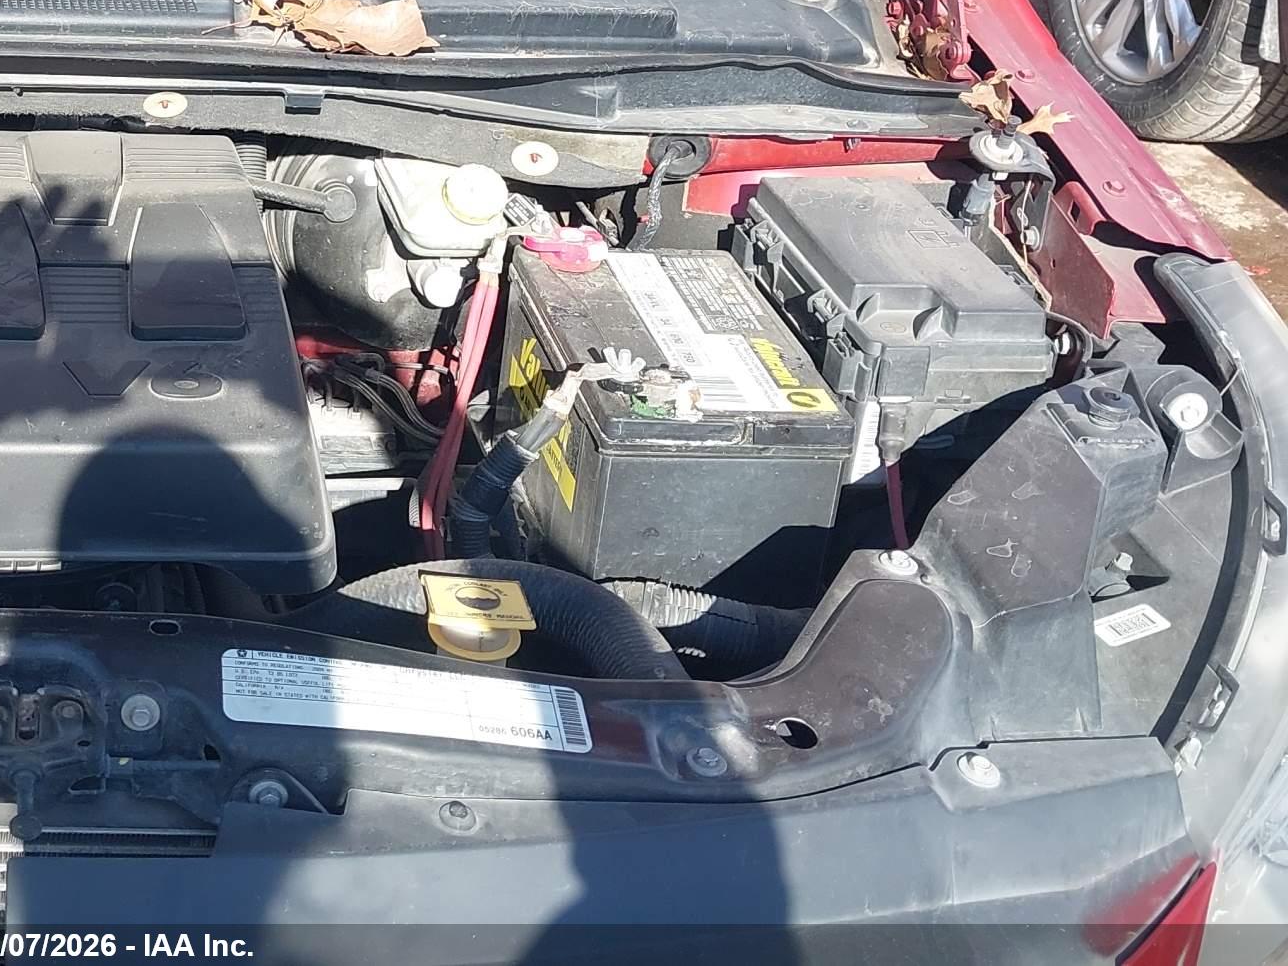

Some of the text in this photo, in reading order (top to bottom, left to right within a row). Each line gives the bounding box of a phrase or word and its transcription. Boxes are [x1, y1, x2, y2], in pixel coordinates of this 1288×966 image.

[61, 359, 224, 400] V6
[286, 654, 316, 662] EMISSION
[511, 726, 552, 741] 606AA
